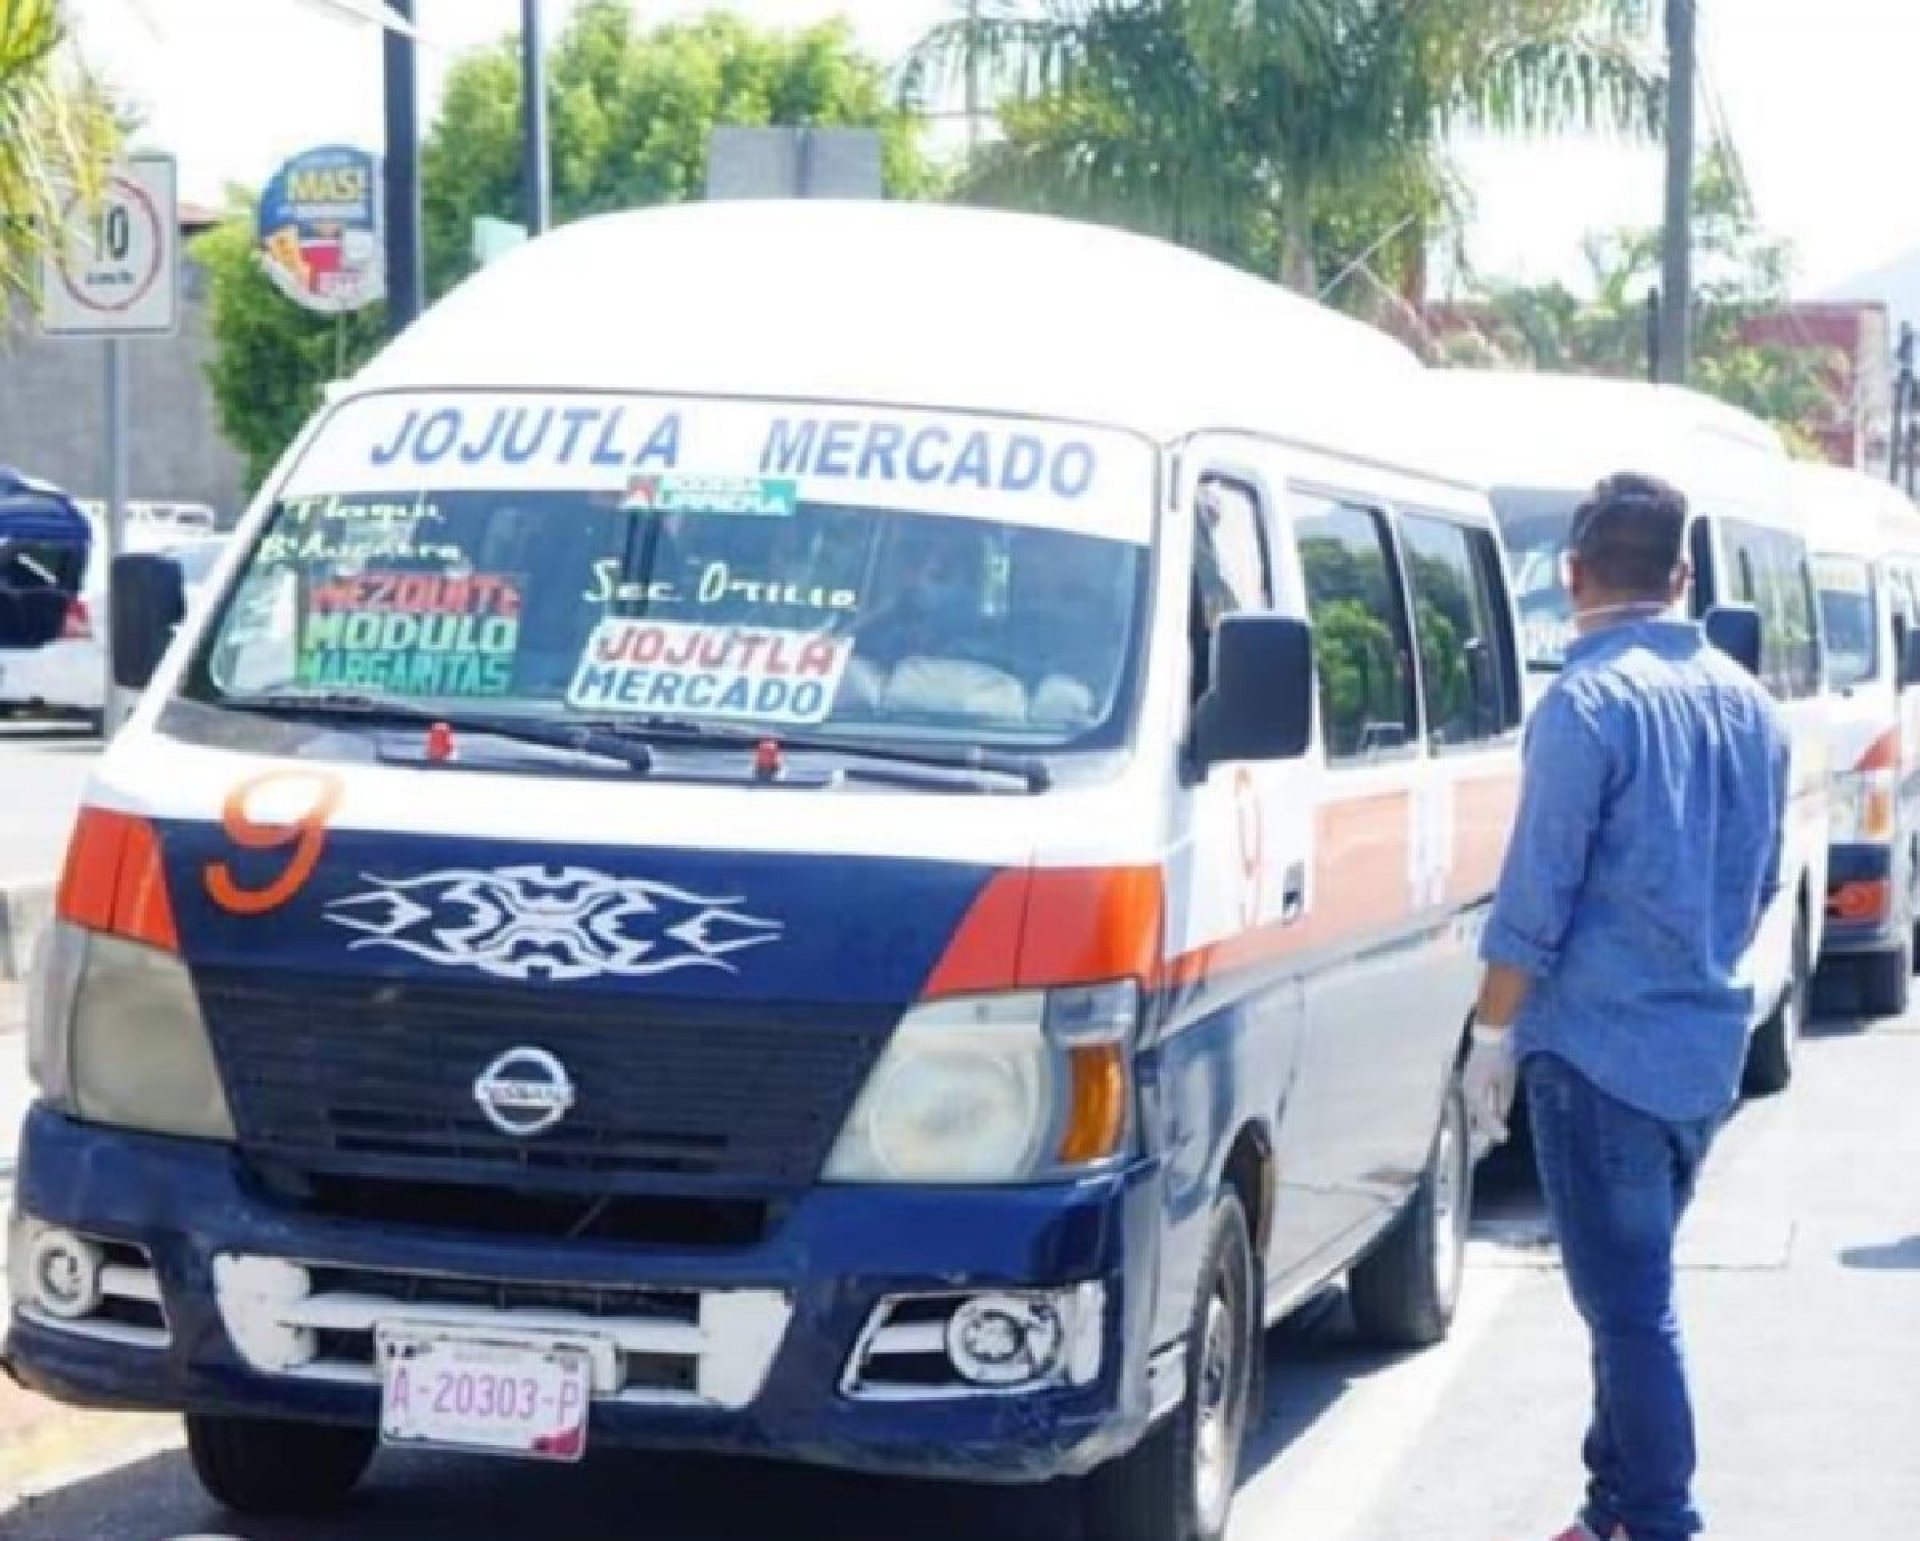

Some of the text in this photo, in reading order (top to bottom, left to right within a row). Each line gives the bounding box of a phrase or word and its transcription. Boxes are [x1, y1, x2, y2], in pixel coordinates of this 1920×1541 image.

[370, 405, 1099, 500] JOJUTLA MERCADO
[305, 612, 519, 654] MODULO
[597, 625, 837, 676] JOJUTLA
[577, 665, 825, 716] MERCADO
[203, 768, 346, 915] 9
[391, 1364, 581, 1424] A-20303-P
